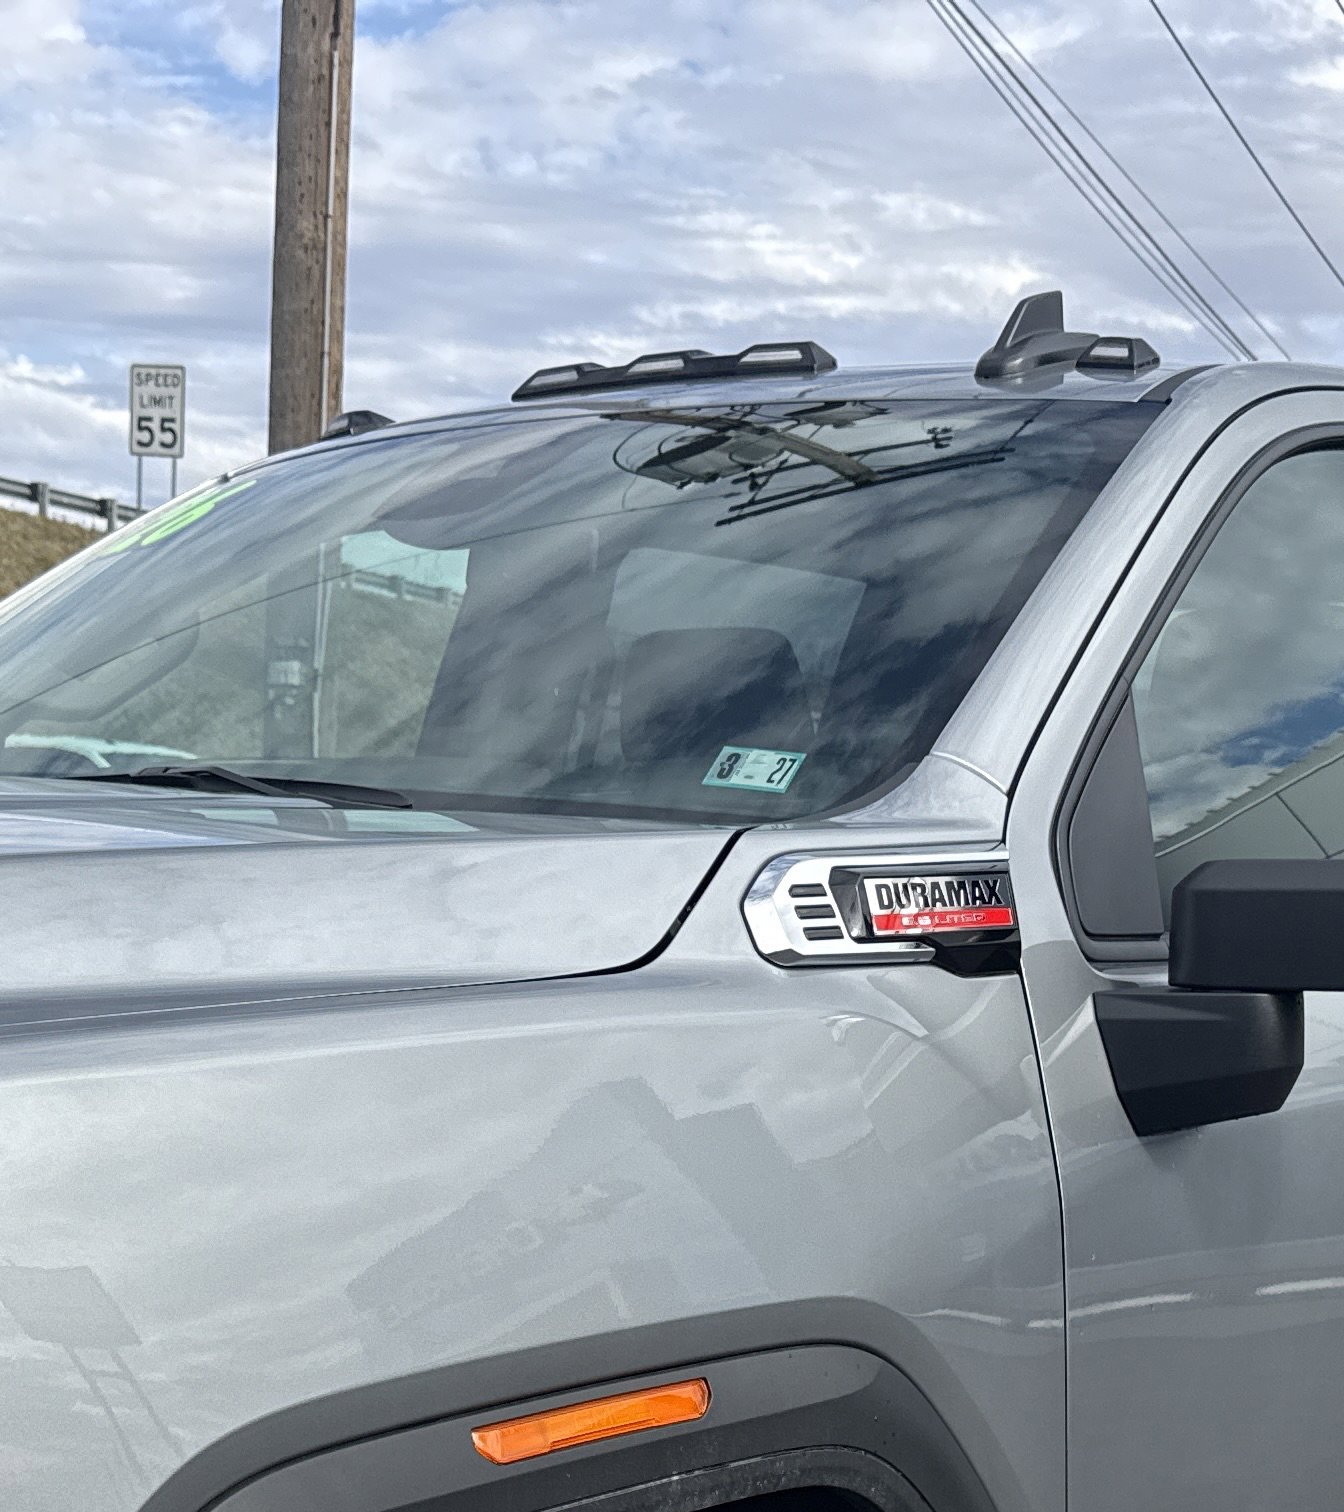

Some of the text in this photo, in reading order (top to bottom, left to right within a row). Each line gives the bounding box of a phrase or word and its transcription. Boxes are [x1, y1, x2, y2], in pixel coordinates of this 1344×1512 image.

[135, 372, 181, 388] SPEED
[139, 394, 175, 409] LIMIT
[136, 416, 179, 449] 55
[766, 757, 799, 787] 27
[874, 878, 1005, 911] DURAMAX
